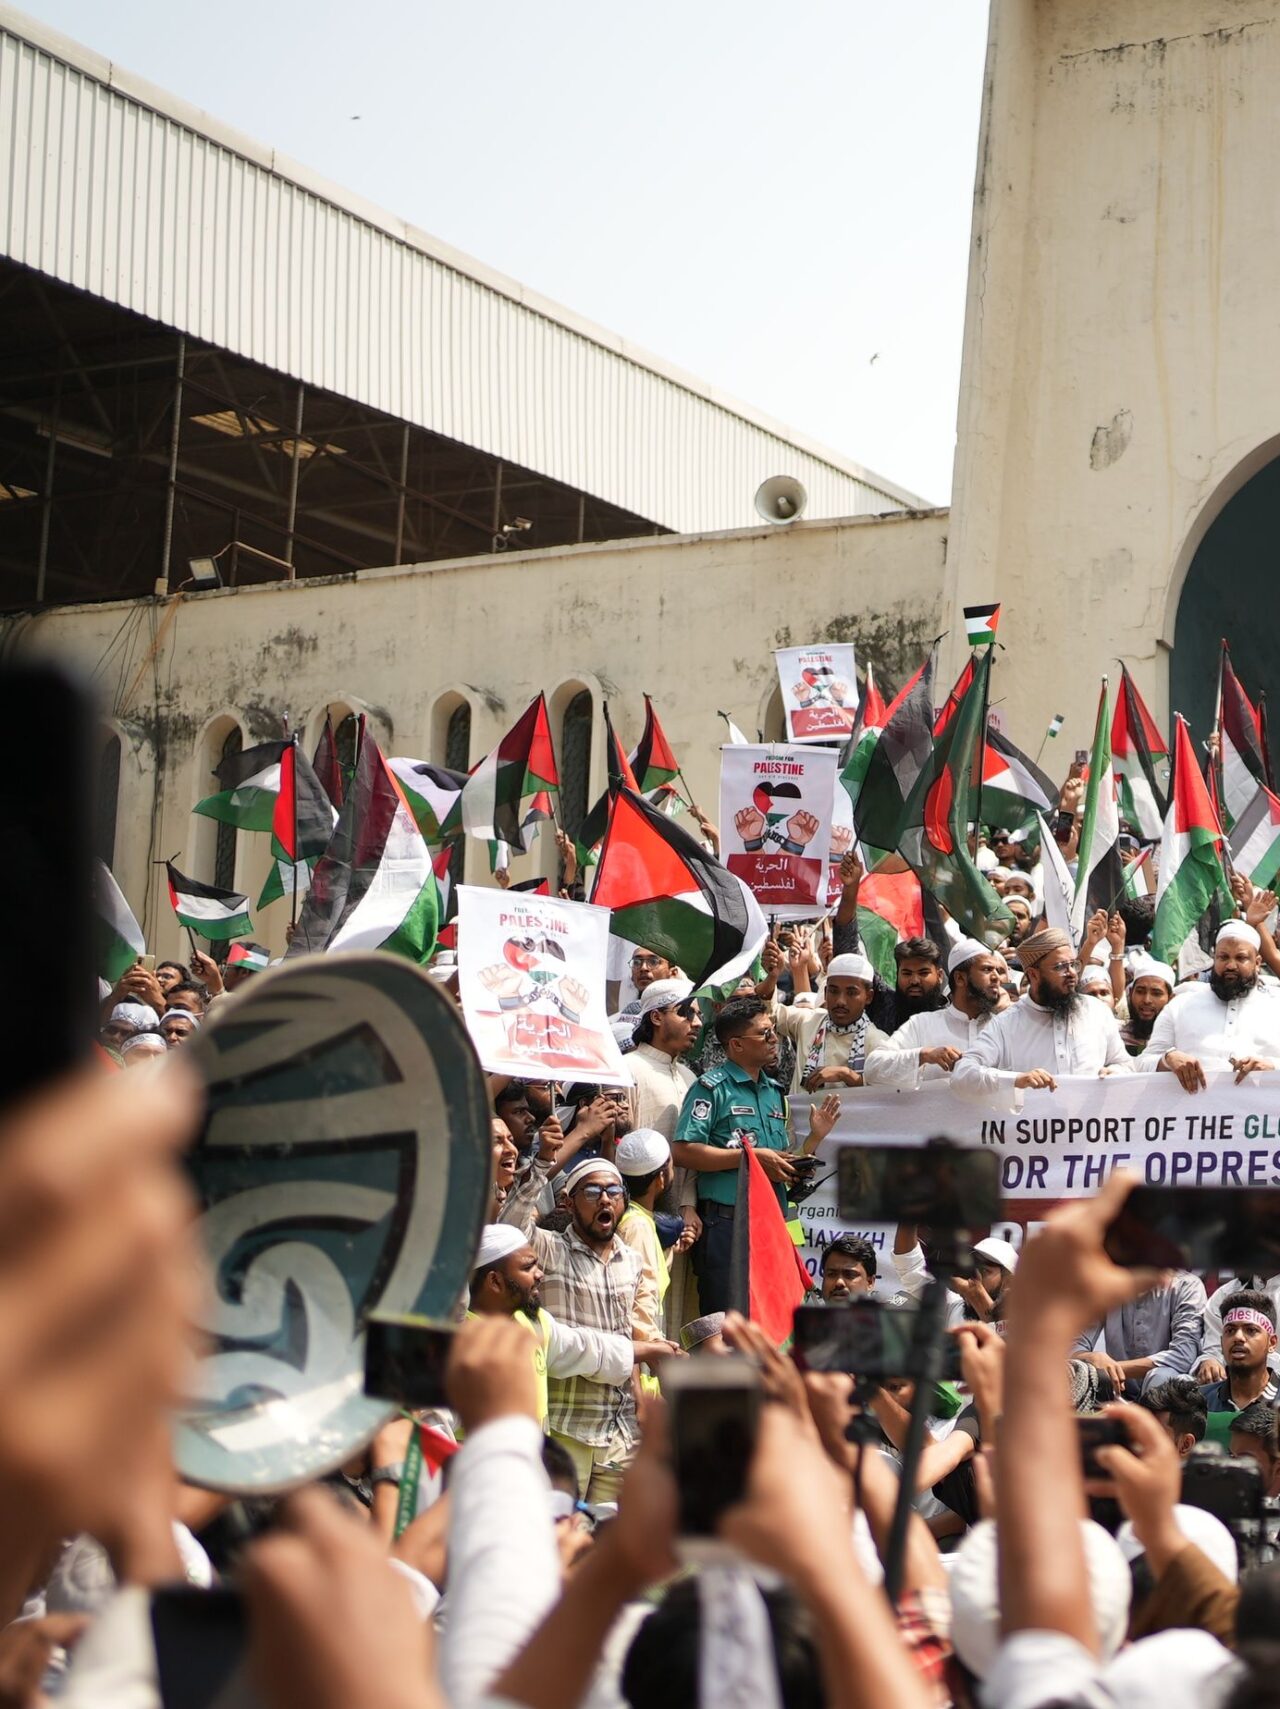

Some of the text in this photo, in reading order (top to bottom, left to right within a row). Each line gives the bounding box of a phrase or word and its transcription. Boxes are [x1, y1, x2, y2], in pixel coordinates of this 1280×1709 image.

[753, 762, 805, 776] PALESTINE
[755, 857, 789, 874] الحرية
[750, 879, 796, 893] لفلسطين
[499, 913, 569, 935] PALESINE
[517, 1017, 571, 1039] الحرية
[981, 1120, 1005, 1144] IN
[1016, 1118, 1135, 1144] SUPPORT
[1144, 1116, 1177, 1142] OF
[1185, 1115, 1234, 1140] THE
[1002, 1155, 1049, 1189] OR
